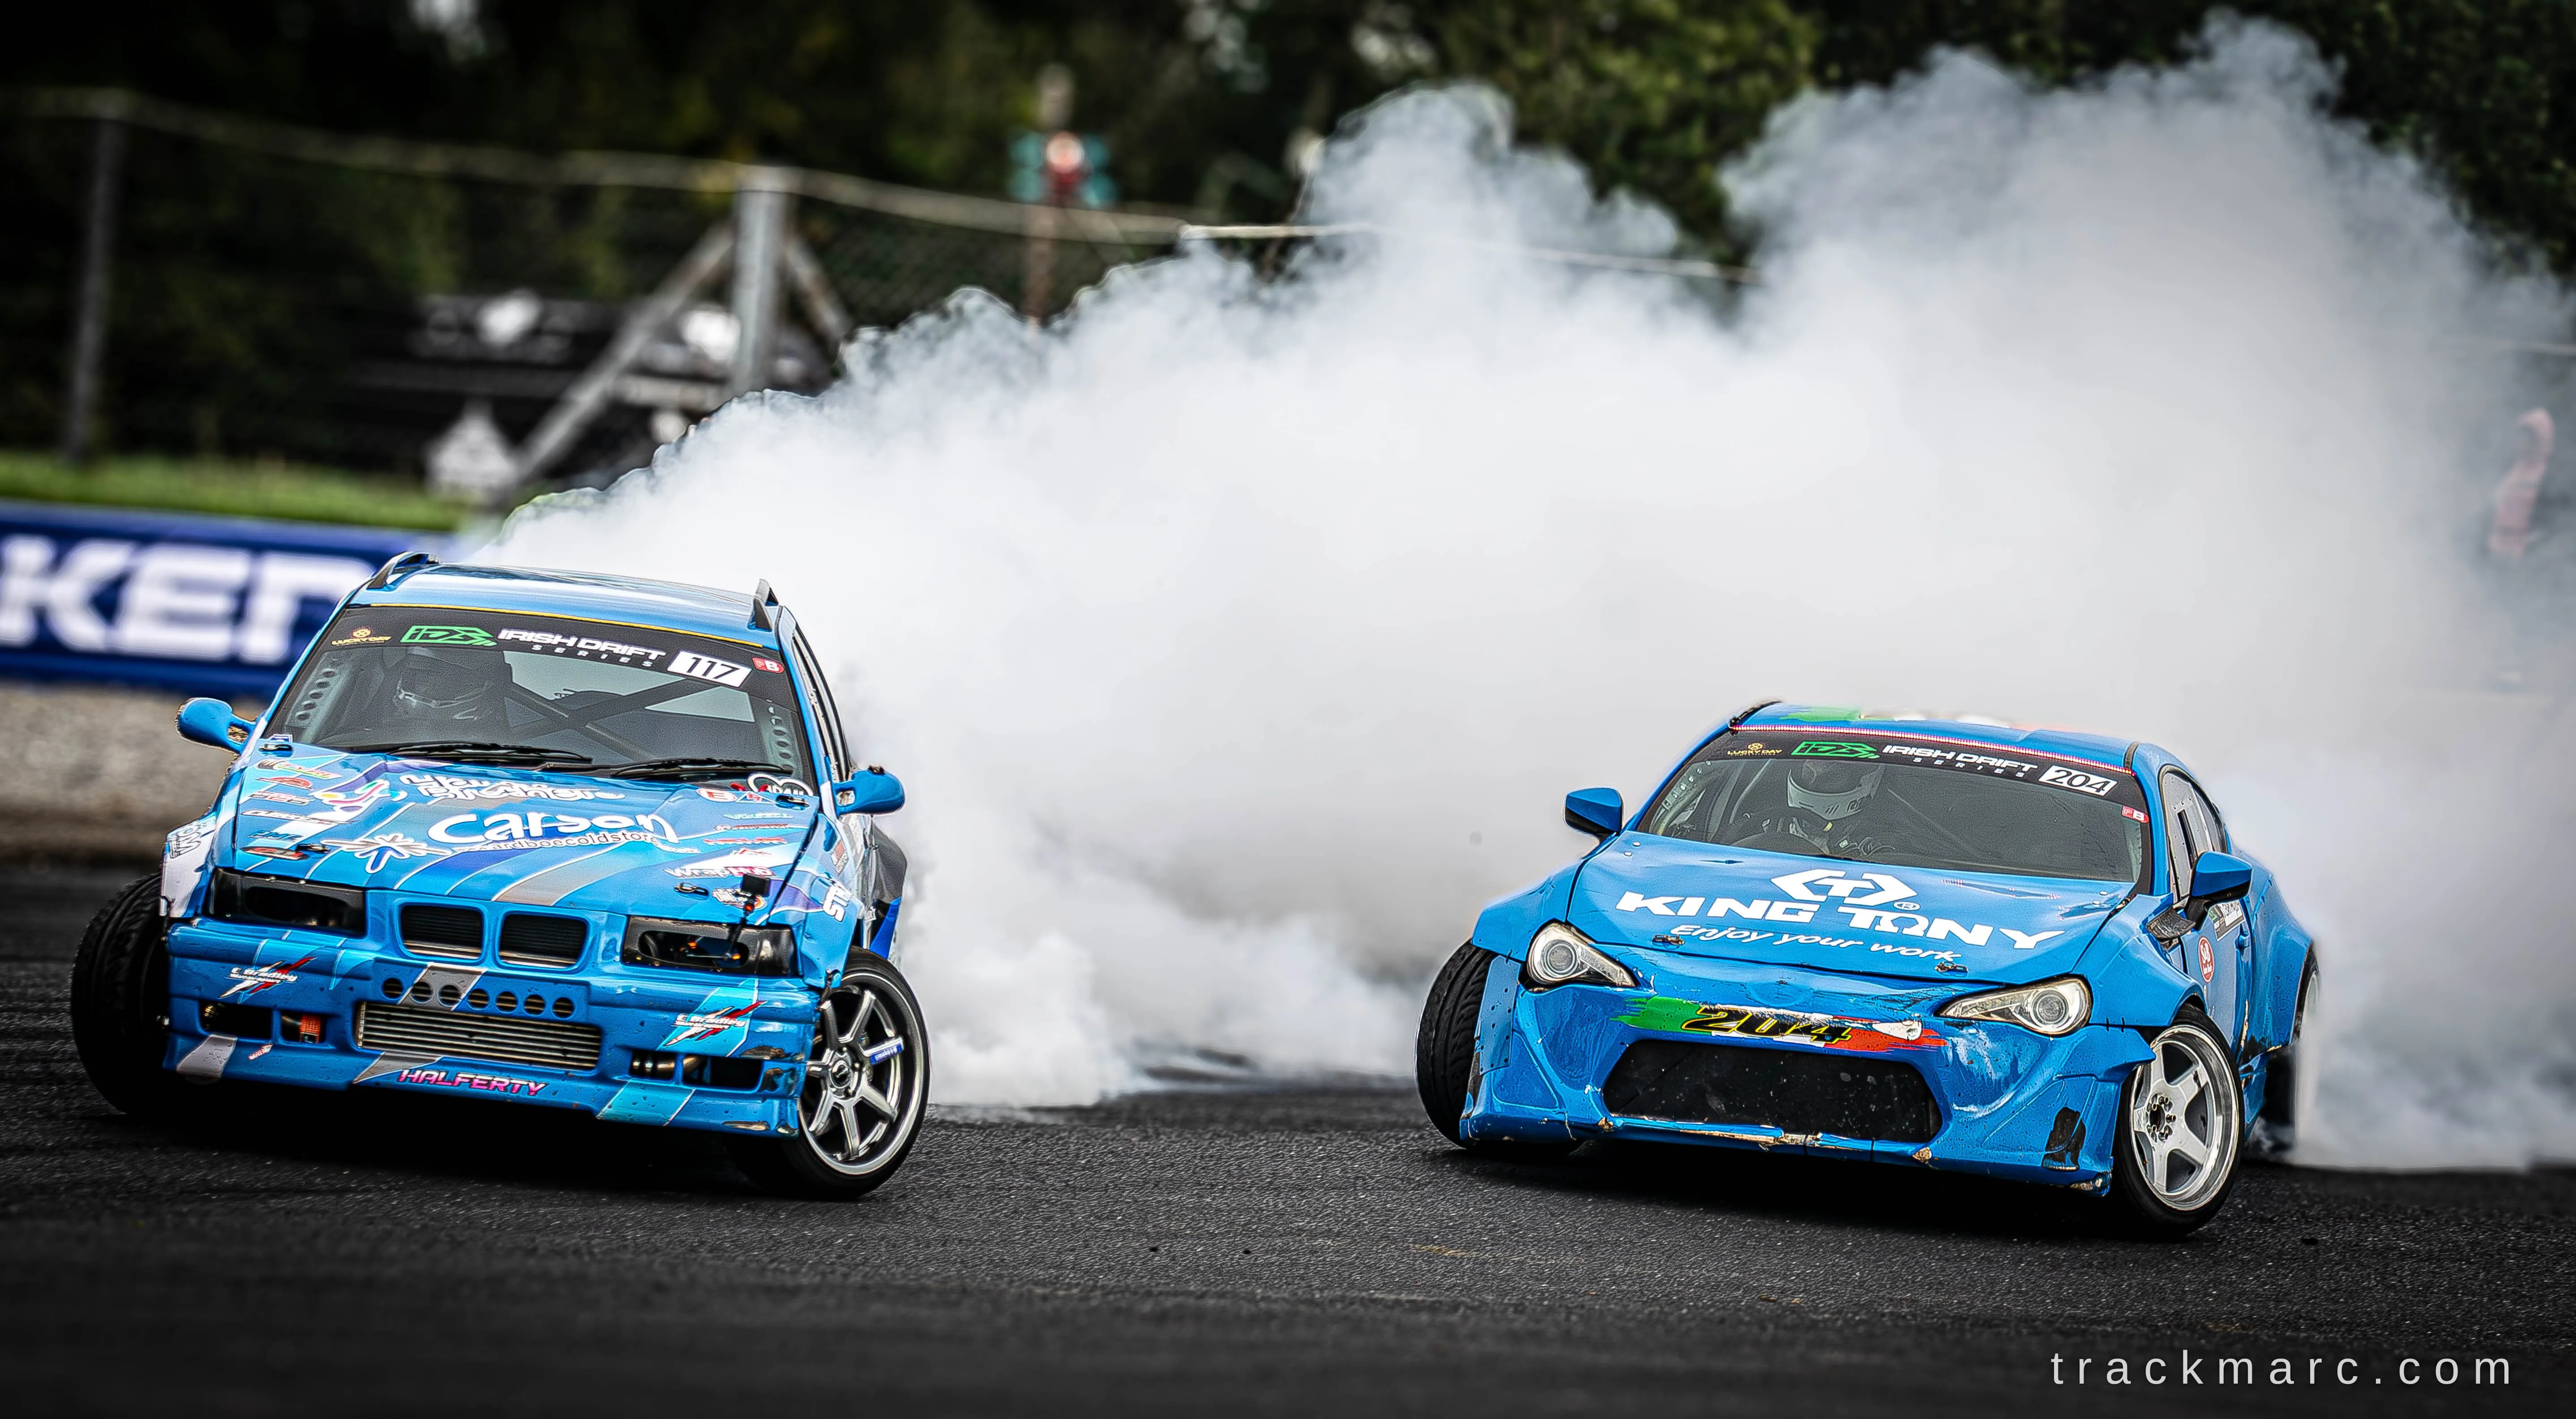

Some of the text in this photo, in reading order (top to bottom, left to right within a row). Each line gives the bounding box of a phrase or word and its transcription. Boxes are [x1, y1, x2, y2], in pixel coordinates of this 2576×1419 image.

[0, 536, 372, 663] KEN
[498, 628, 666, 660] IRISH DRIFT
[531, 645, 653, 667] SERIES
[686, 657, 740, 679] 117
[1882, 745, 2038, 771] IRISH DRIFT
[1913, 757, 2025, 778] SERIES
[2045, 769, 2111, 793] 204
[428, 812, 680, 844] Carson
[1615, 891, 2066, 949] KING TONY
[1670, 924, 1962, 962] Enjoy your work
[244, 968, 298, 982] Bradley
[690, 1016, 747, 1027] Bradley
[1682, 1004, 1852, 1044] 204
[398, 1068, 550, 1096] HALFERTY
